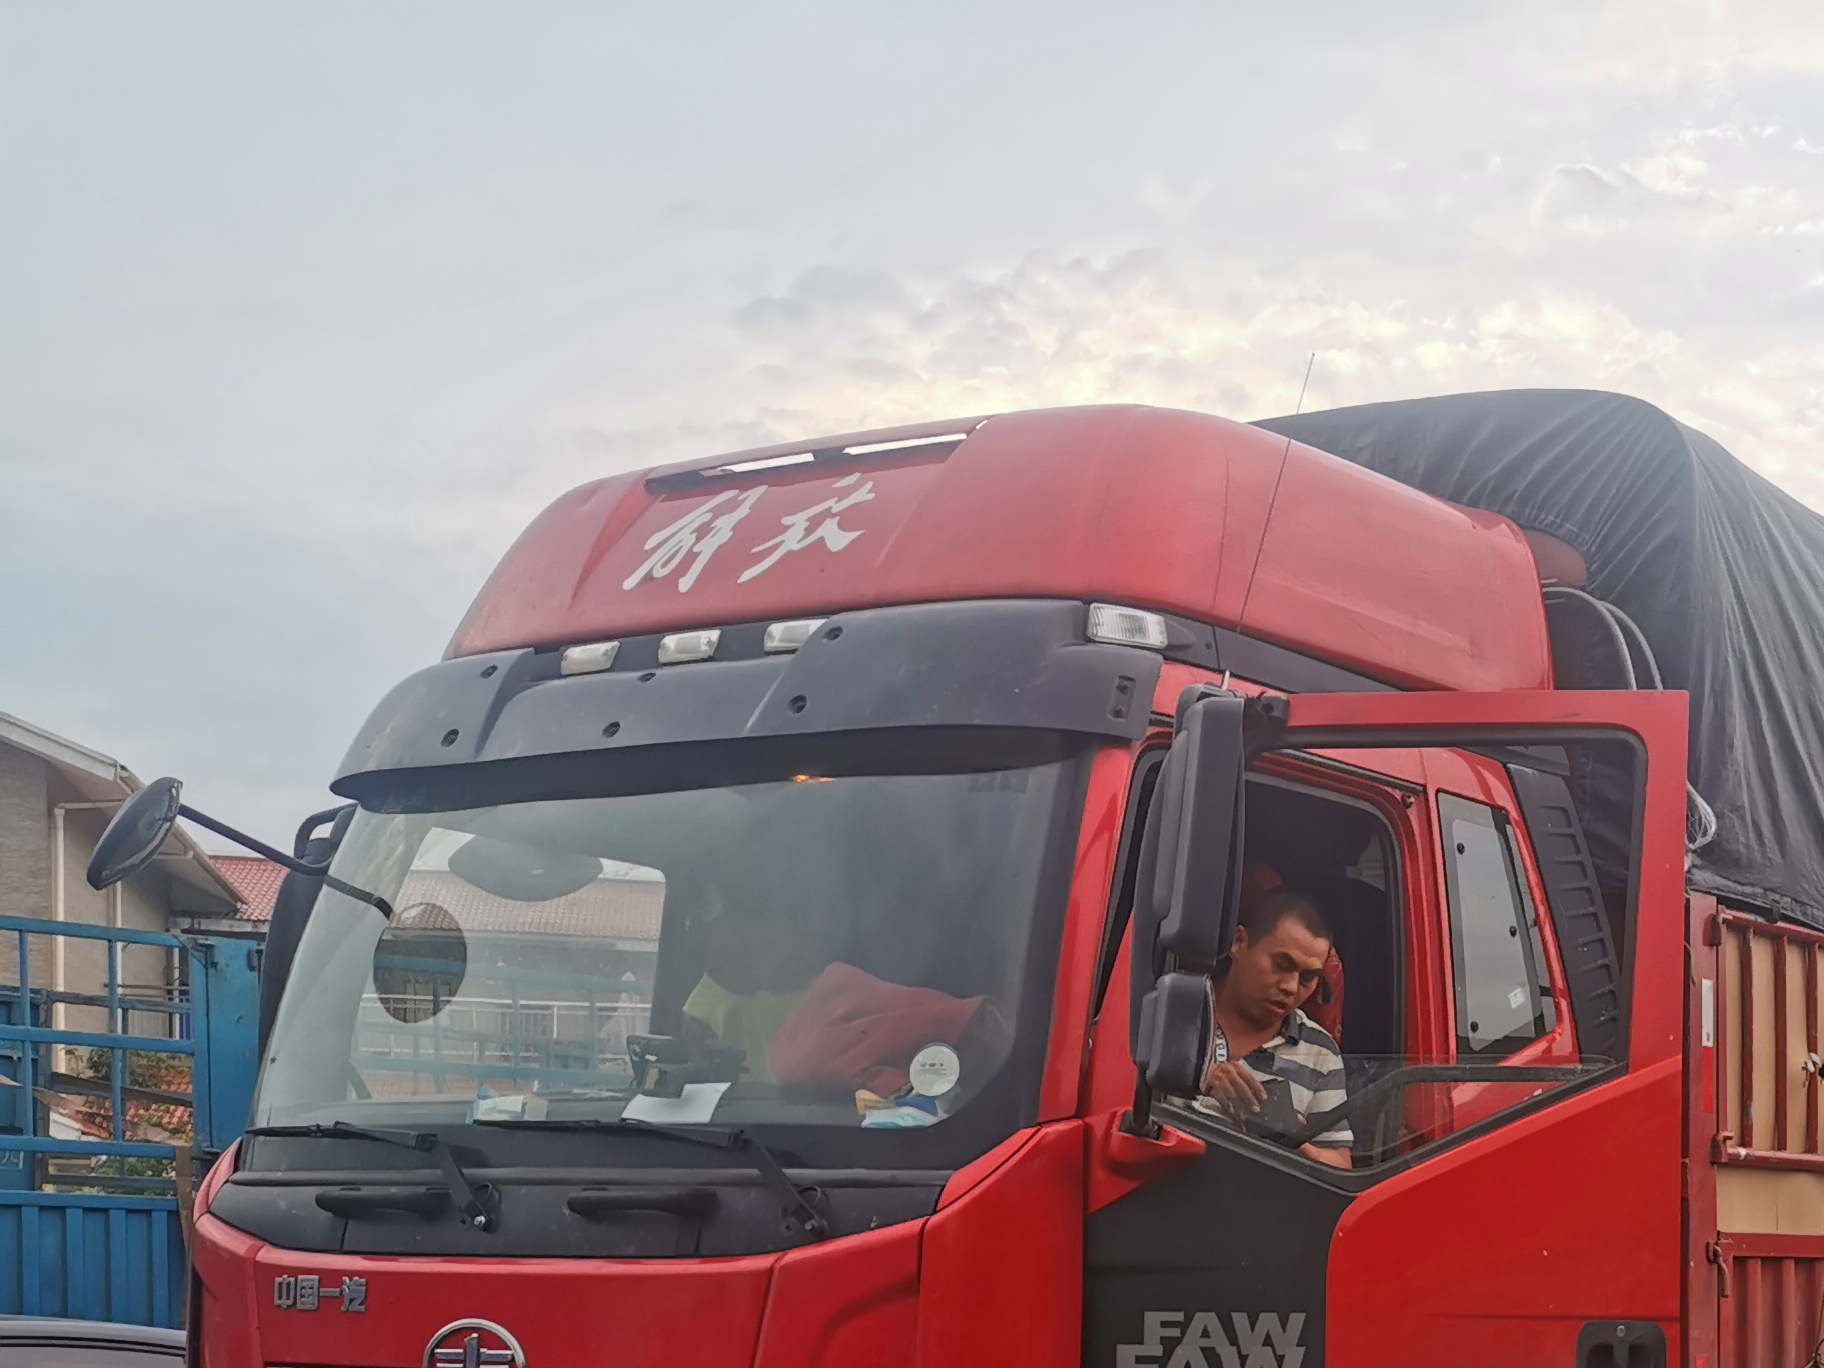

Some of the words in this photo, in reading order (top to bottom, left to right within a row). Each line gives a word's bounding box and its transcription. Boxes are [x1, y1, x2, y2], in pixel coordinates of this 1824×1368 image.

[622, 472, 876, 593] 解放
[273, 1274, 367, 1312] 中国一汽
[1143, 1310, 1306, 1349] FAW
